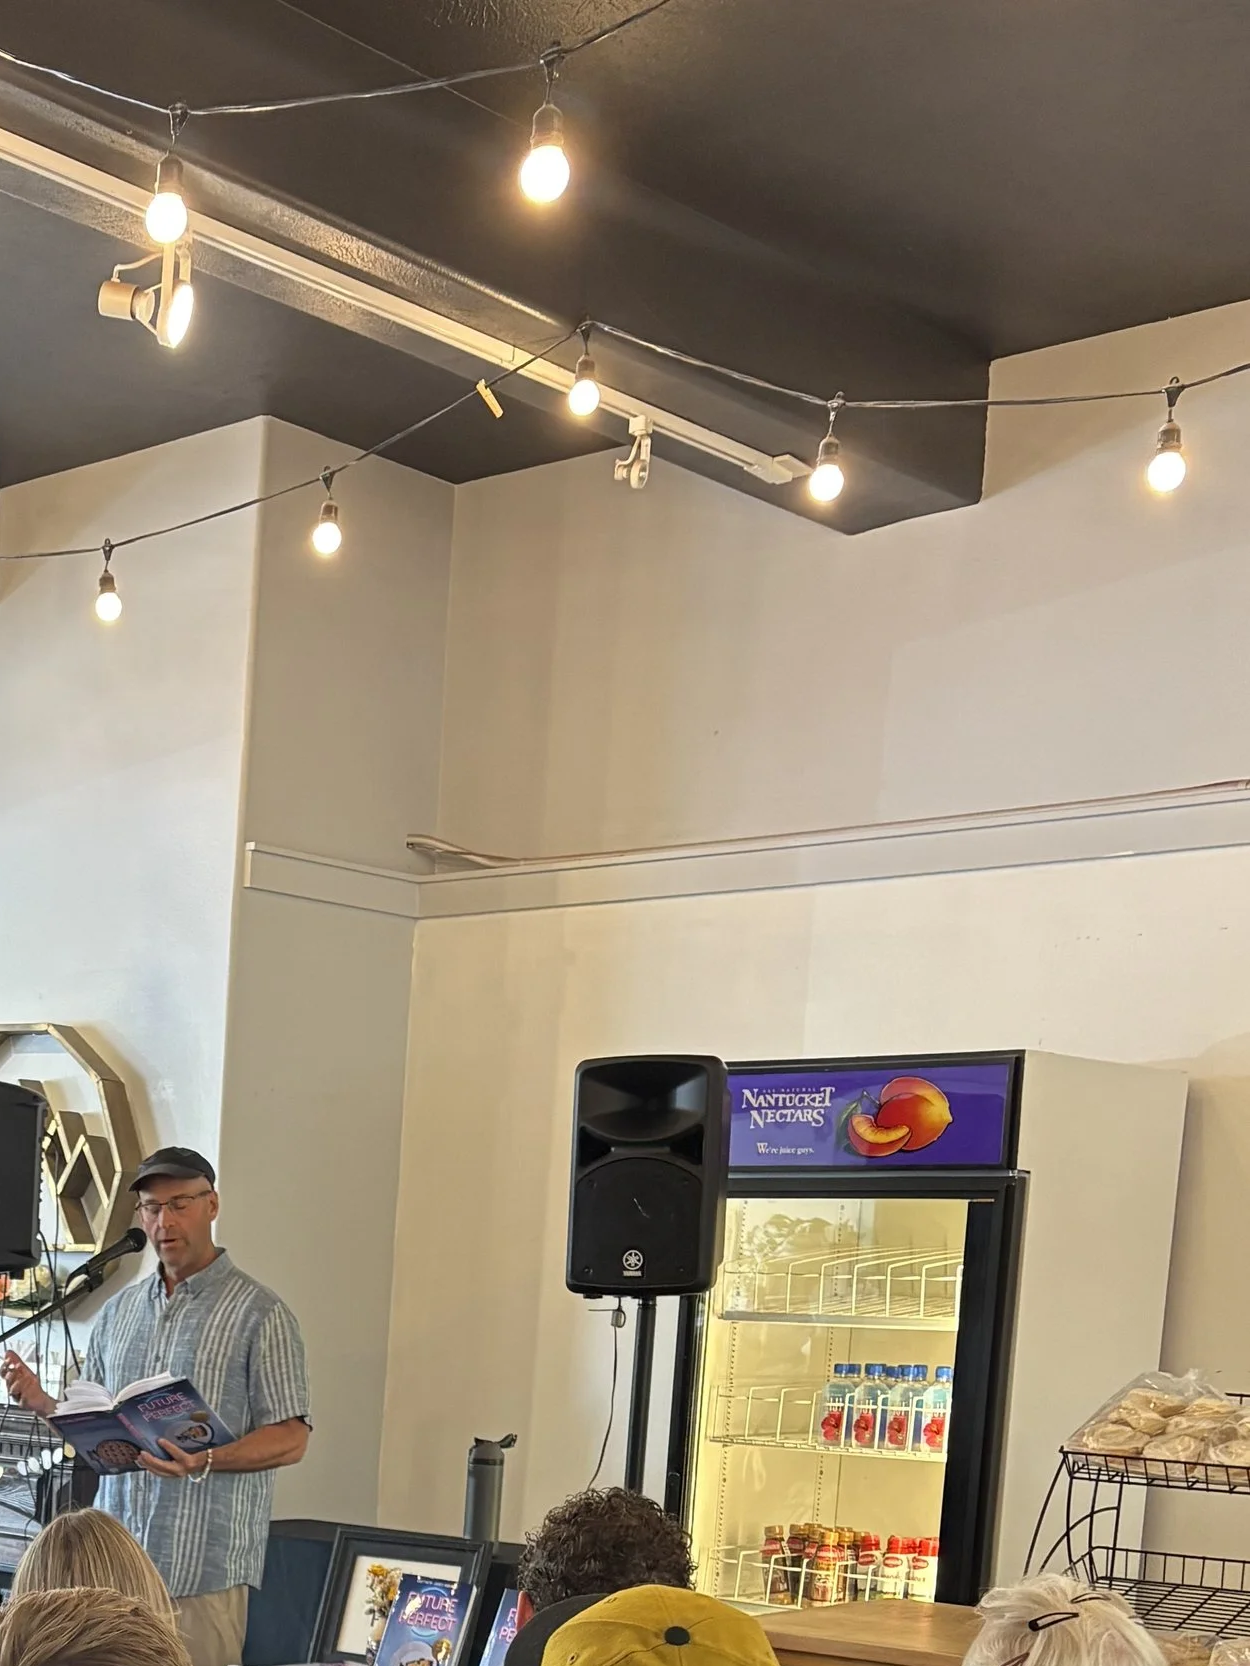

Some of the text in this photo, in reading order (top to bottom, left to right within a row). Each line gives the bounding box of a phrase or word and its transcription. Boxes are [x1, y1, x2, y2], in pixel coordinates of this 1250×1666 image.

[742, 1087, 835, 1109] NANTUCKET
[750, 1109, 824, 1129] NECTARS
[137, 1392, 187, 1413] FUTURE
[142, 1400, 196, 1423] PERFECT
